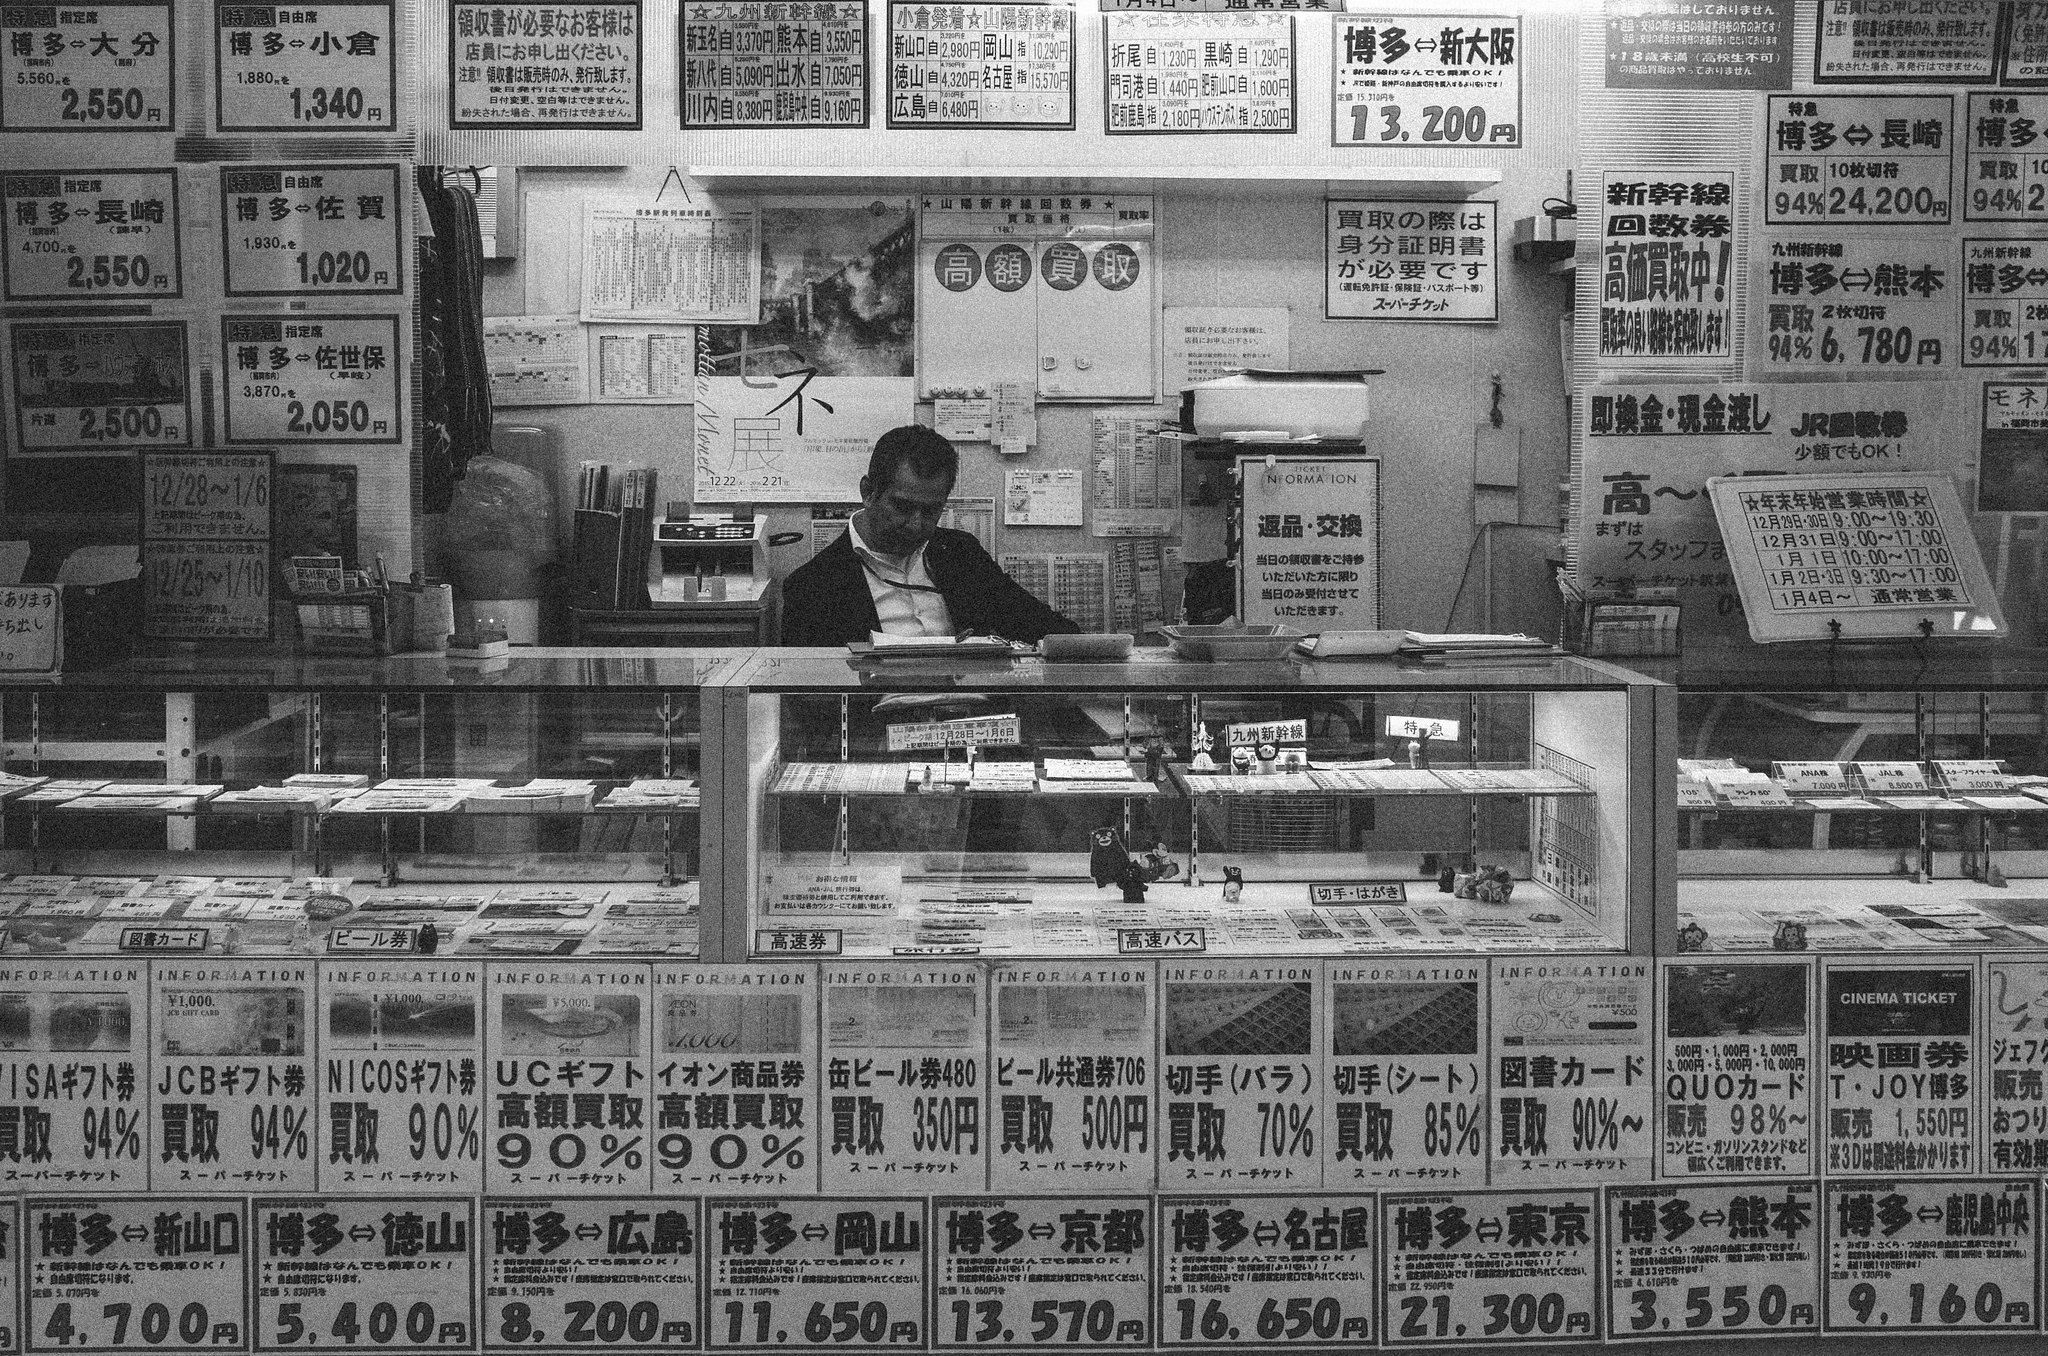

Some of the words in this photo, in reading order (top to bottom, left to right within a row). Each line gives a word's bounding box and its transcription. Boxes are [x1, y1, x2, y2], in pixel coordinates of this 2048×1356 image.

[60, 12, 98, 24] 指定席
[278, 12, 317, 24] 自由席
[459, 10, 634, 37] 領収書が必要なお客様は
[715, 4, 837, 19] 九州新幹線
[897, 6, 964, 30] 小倉発着
[984, 8, 1068, 30] 山陽新幹線
[11, 32, 66, 56] 博多
[90, 31, 160, 56] 大分
[309, 31, 380, 56] 小倉
[465, 43, 632, 61] 店員にお申し出ください。
[687, 25, 717, 52] 新玉名
[736, 30, 772, 53] 3,370円
[777, 23, 807, 53] 熊本
[827, 29, 861, 54] 3,550円
[895, 34, 924, 59] 新山口
[942, 41, 980, 59] 2,980円
[984, 34, 1012, 60] 岡山
[1344, 27, 1411, 66] 博多
[1440, 27, 1514, 66] 新大阪
[1112, 44, 1140, 67] 折尾
[1162, 50, 1196, 68] 1,230円
[1205, 42, 1232, 67] 黒崎
[687, 58, 716, 88] 新八代
[895, 63, 923, 89] 徳山
[983, 65, 1012, 89] 名古屋
[1111, 74, 1143, 99] 門司港
[61, 87, 161, 121] 2,550円
[290, 87, 382, 121] 1,340円
[894, 93, 925, 118] 広島
[1351, 105, 1516, 142] 13,200円
[1777, 121, 1837, 150] 博多
[1880, 120, 1942, 149] 長崎
[1829, 162, 1899, 179] 10枚切符
[316, 195, 385, 221] 佐賀
[1607, 183, 1730, 206] 新幹線
[1775, 192, 1824, 215] 94%
[1829, 187, 1947, 217] 24,200円
[16, 200, 70, 225] 博多
[95, 199, 163, 224] 長崎
[1337, 211, 1485, 230] 買取の際は
[1607, 214, 1730, 238] 回数券
[1337, 236, 1486, 256] 身分証明書
[1772, 243, 1843, 257] 九州新幹線
[67, 255, 167, 289] 2,550円
[297, 251, 388, 284] 1,020円
[1337, 260, 1488, 279] が必要です
[1605, 241, 1731, 303] 高価買取中!
[1874, 264, 1944, 297] 熊本
[1373, 298, 1449, 312] スーパーチケット
[1822, 306, 1886, 320] 2枚切符
[285, 326, 323, 338] 指定席
[1821, 326, 1941, 364] 6,780円
[236, 346, 291, 371] 博多
[315, 346, 385, 370] 佐世保
[79, 407, 178, 440] 2,500円
[287, 401, 388, 434] 2,050円
[1591, 394, 1770, 434] 即換金・現金渡し
[1761, 491, 1906, 512] 年末年始営業時間
[1258, 514, 1363, 538] 返品・交換
[1596, 521, 1643, 536] まずは
[1833, 510, 1934, 528] 9:00～19:30
[1762, 533, 1836, 548] 12月31日
[1839, 530, 1941, 547] 9:00～17:00
[1256, 554, 1365, 565] 当日の領収書をご持参
[1843, 549, 1949, 565] 10:00～17:00
[1262, 571, 1358, 582] いただいた方に限り
[1852, 568, 1957, 584] 9:30～17:00
[1872, 588, 1957, 603] 通常営業
[1274, 606, 1344, 616] いただきます。
[1232, 724, 1304, 743] 九州新幹線
[1404, 720, 1444, 737] 特急
[1317, 886, 1399, 901] 切手・はがき
[130, 932, 199, 946] 図書カード
[335, 929, 408, 948] ビール券
[771, 932, 827, 950] 高速券
[1126, 931, 1197, 949] 高速バス
[1840, 993, 1898, 1005] CINEMA
[1903, 992, 1957, 1004] TICKET
[1830, 1042, 1968, 1069] 映画券
[159, 1064, 305, 1097] JCBギフト券
[328, 1059, 476, 1095] NICOSギフト券
[497, 1062, 643, 1088] UCギフト
[658, 1062, 804, 1088] イオン商品券
[829, 1057, 976, 1089] 缶ビール券480
[998, 1056, 1145, 1087] ビール共通券706
[1166, 1064, 1312, 1096] 切手(バラ)
[1333, 1064, 1479, 1095] 切手(シート)
[1501, 1056, 1644, 1088] 図書カード
[1667, 1074, 1804, 1100] QUOカード
[498, 1094, 643, 1129] 高額買取
[913, 1097, 978, 1154] 350円
[1082, 1095, 1148, 1153] 500円
[1667, 1105, 1706, 1137] 販売
[1831, 1108, 1872, 1138] 販売
[1896, 1107, 1968, 1138] 1,550円
[251, 1105, 307, 1160] 94%
[330, 1103, 379, 1163] 買取
[409, 1104, 479, 1161] 90%
[1258, 1103, 1313, 1157] 70%
[1425, 1103, 1480, 1157] 85%
[497, 1134, 642, 1169] 90%
[1284, 1207, 1367, 1251] 名古屋
[1395, 1205, 1471, 1250] 博多
[1506, 1203, 1590, 1247] 東京
[1728, 1195, 1812, 1241] 熊本
[1838, 1193, 1913, 1237] 博多
[39, 1212, 117, 1256] 博多
[154, 1212, 239, 1256] 新山口
[382, 1212, 466, 1256] 徳山
[494, 1210, 571, 1255] 博多
[607, 1210, 693, 1254] 広島
[835, 1210, 920, 1255] 岡山
[947, 1210, 1023, 1255] 博多
[1060, 1209, 1144, 1253] 京都
[1400, 1293, 1590, 1338] 21,300円
[1630, 1284, 1814, 1330] 3,550円
[1849, 1282, 2030, 1324] 9,160円
[45, 1303, 238, 1345] 4,700円
[277, 1302, 465, 1345] 5,400円
[500, 1302, 691, 1343] 8,200円
[725, 1302, 918, 1343] 11,650円
[952, 1300, 1144, 1342] 13,570円
[1177, 1298, 1368, 1341] 16,650円
